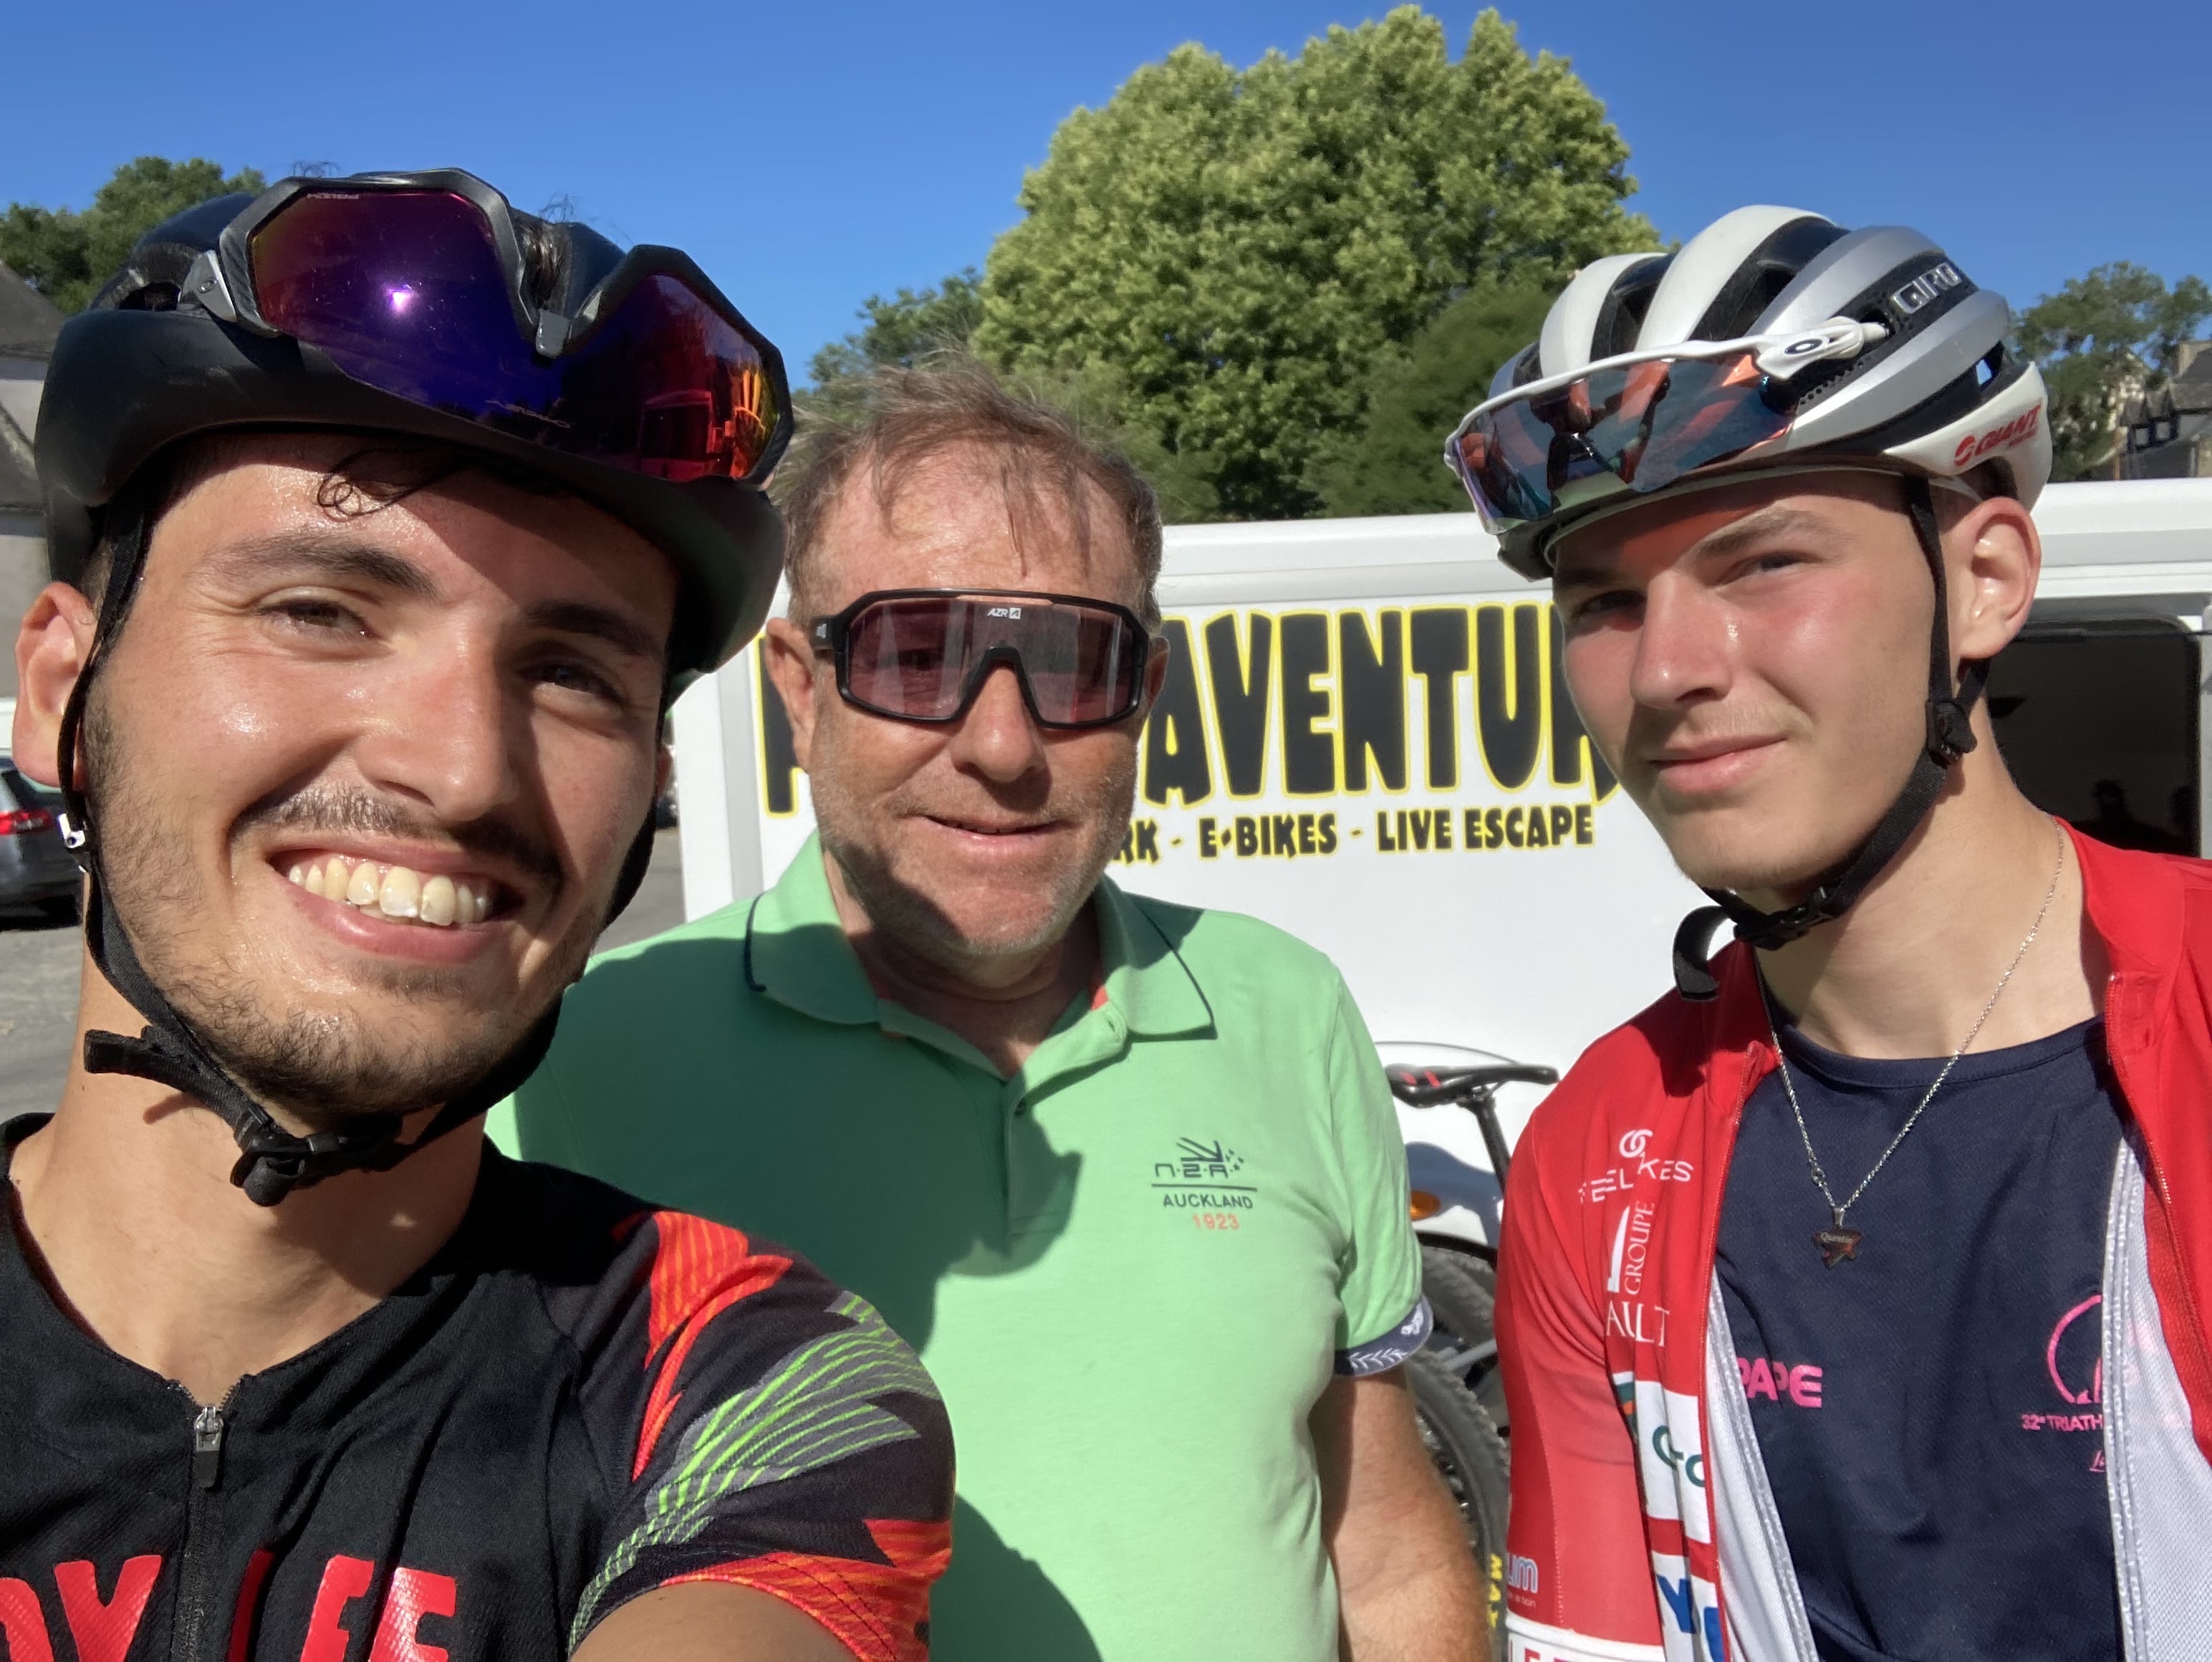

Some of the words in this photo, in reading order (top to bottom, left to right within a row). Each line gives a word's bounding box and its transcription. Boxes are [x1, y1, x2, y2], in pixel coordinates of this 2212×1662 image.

[1893, 261, 1962, 315] GIRO
[987, 607, 1009, 618] AZR
[1376, 807, 1453, 852] LIVE
[1463, 804, 1595, 850] ESCAPE
[1163, 1193, 1254, 1209] AUCKLAND
[1192, 1212, 1240, 1230] 1923
[1623, 1200, 1655, 1295] GROUPE
